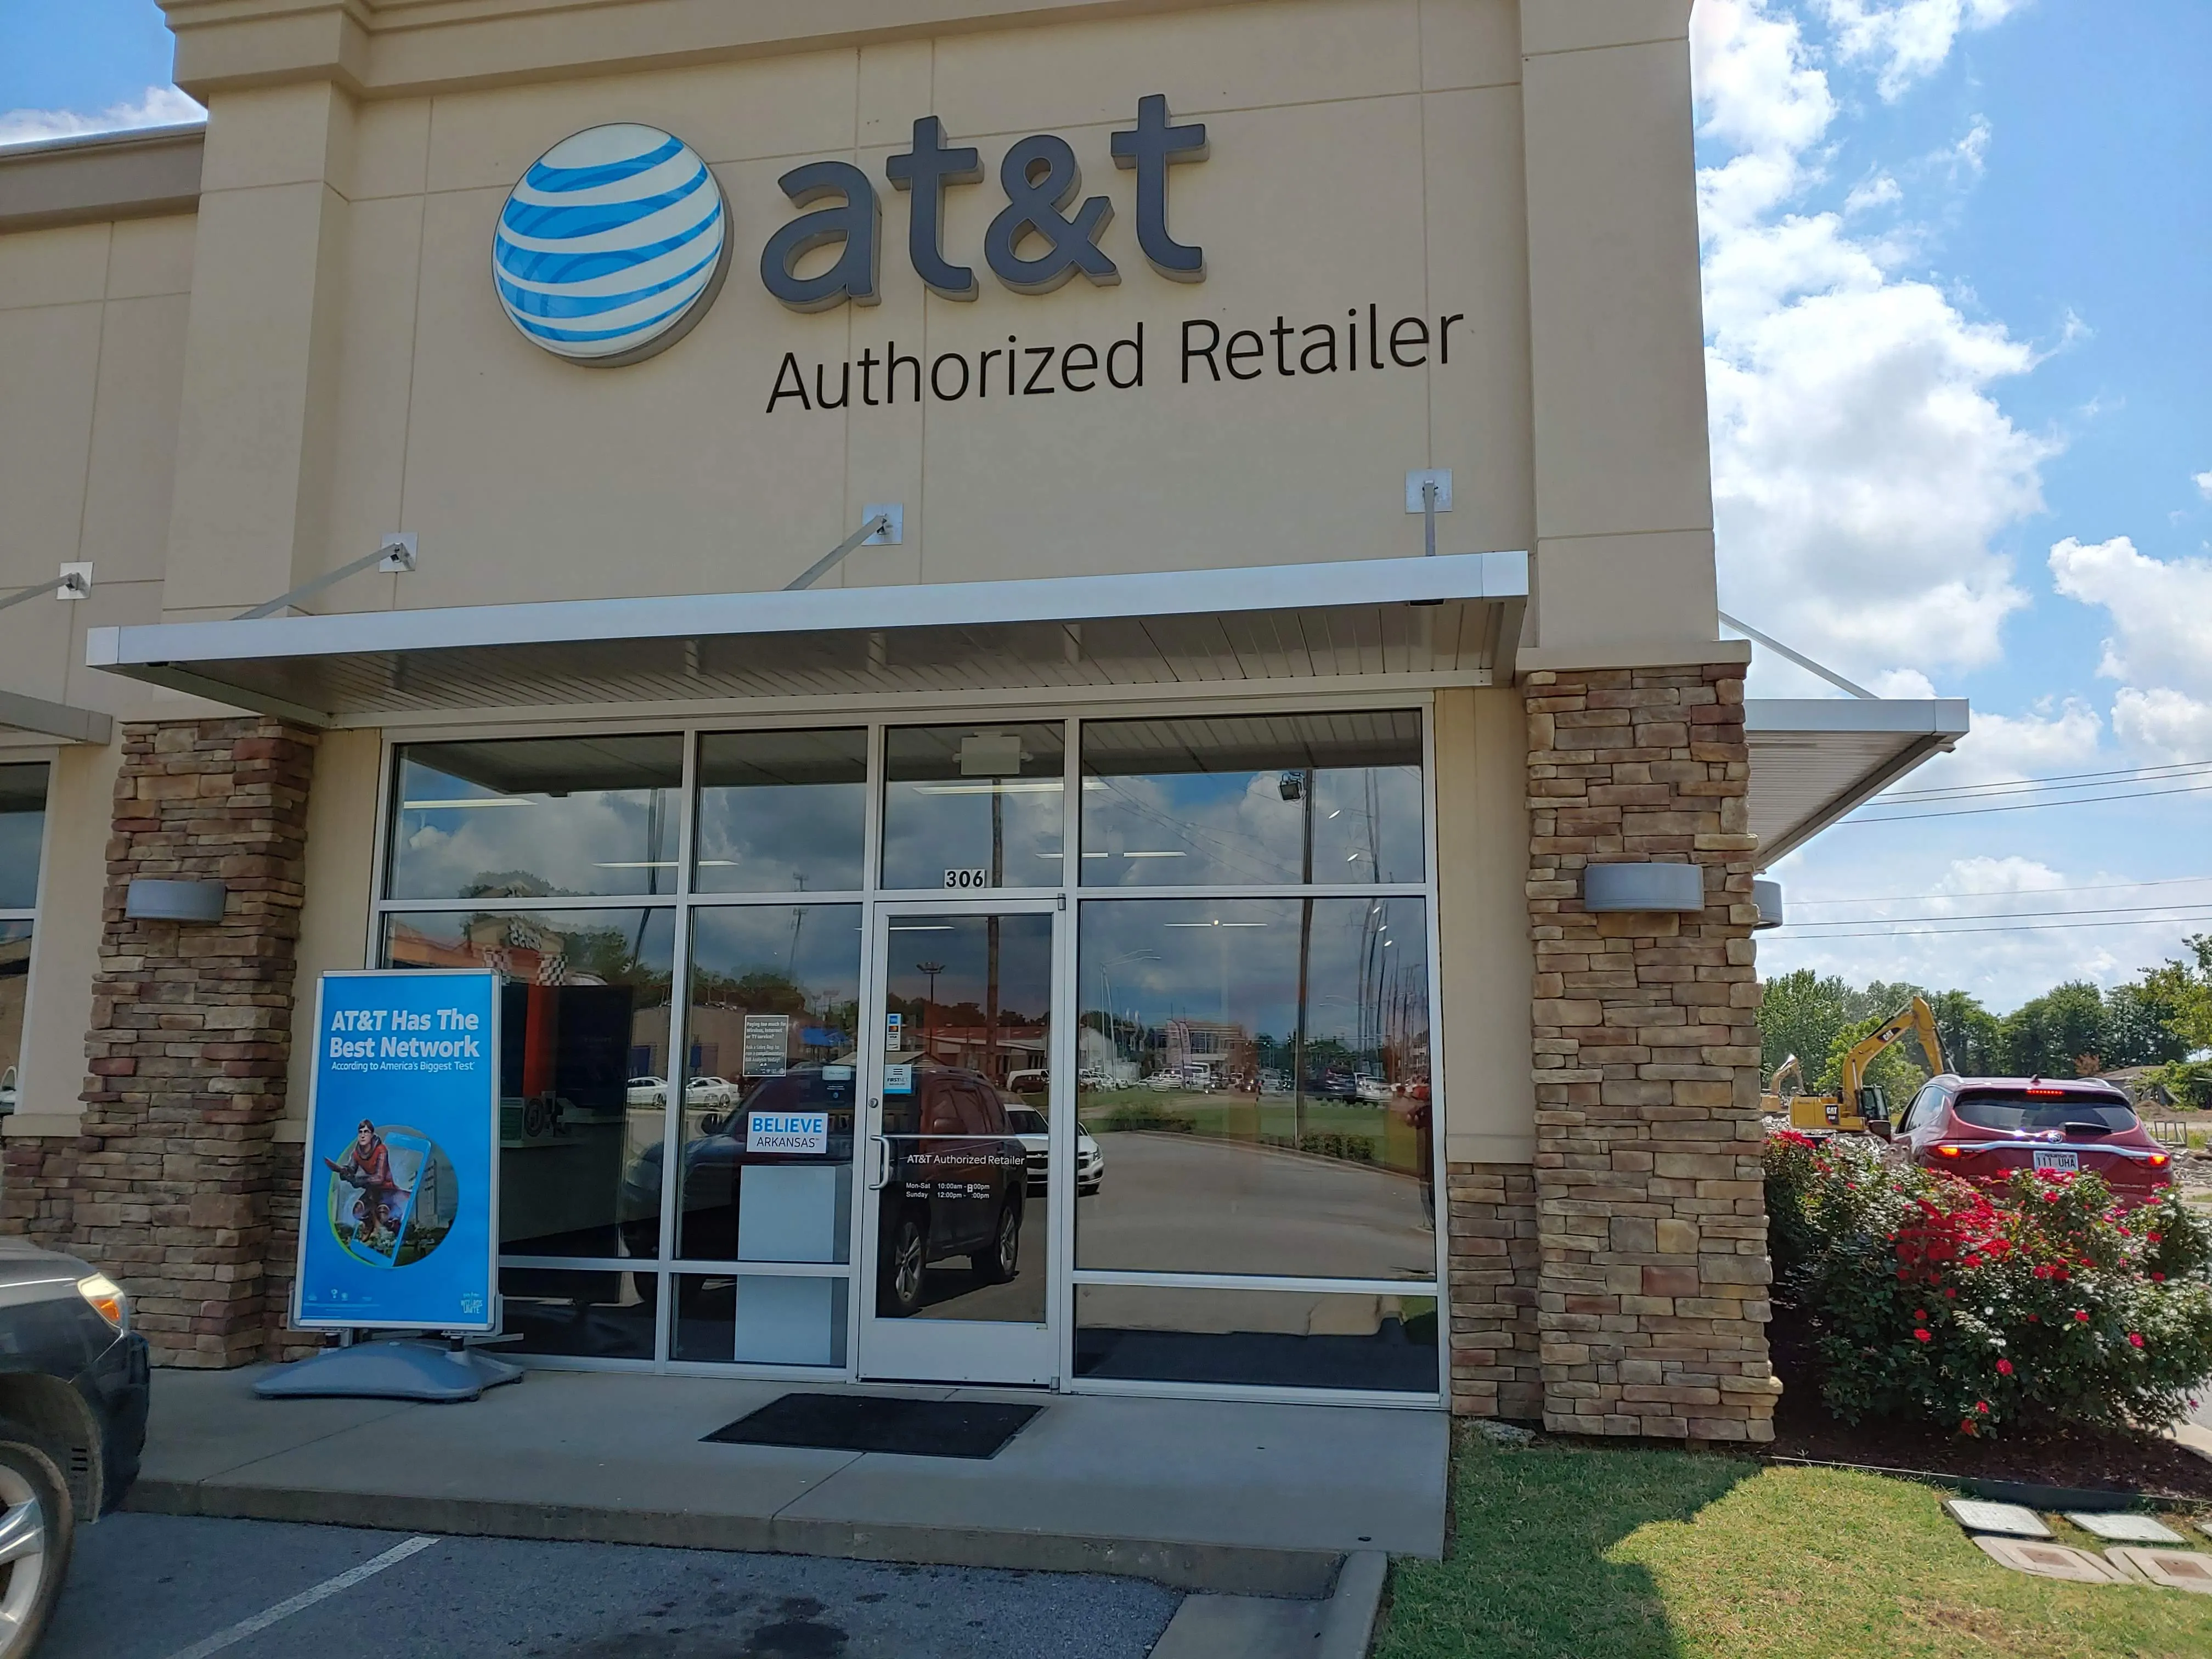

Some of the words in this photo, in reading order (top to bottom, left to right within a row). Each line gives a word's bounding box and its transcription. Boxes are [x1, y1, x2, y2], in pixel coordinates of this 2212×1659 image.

[765, 321, 1145, 413] Authorized
[1181, 303, 1464, 384] Retailer
[946, 871, 983, 888] 306
[331, 1010, 388, 1031] AT&T
[391, 1010, 431, 1031] Has
[437, 1008, 479, 1030] The
[1882, 1029, 1894, 1041] CAT
[330, 1036, 376, 1058] Best
[380, 1035, 480, 1058] Network
[331, 1061, 368, 1073] According
[370, 1062, 379, 1070] to
[380, 1061, 419, 1070] America's
[420, 1062, 452, 1073] Biggest
[753, 1117, 822, 1133] BELIEVE
[756, 1136, 815, 1148] ARKANSAS
[907, 1155, 932, 1164] AT&T
[933, 1155, 986, 1164] Authorized
[988, 1155, 1025, 1165] Retailer
